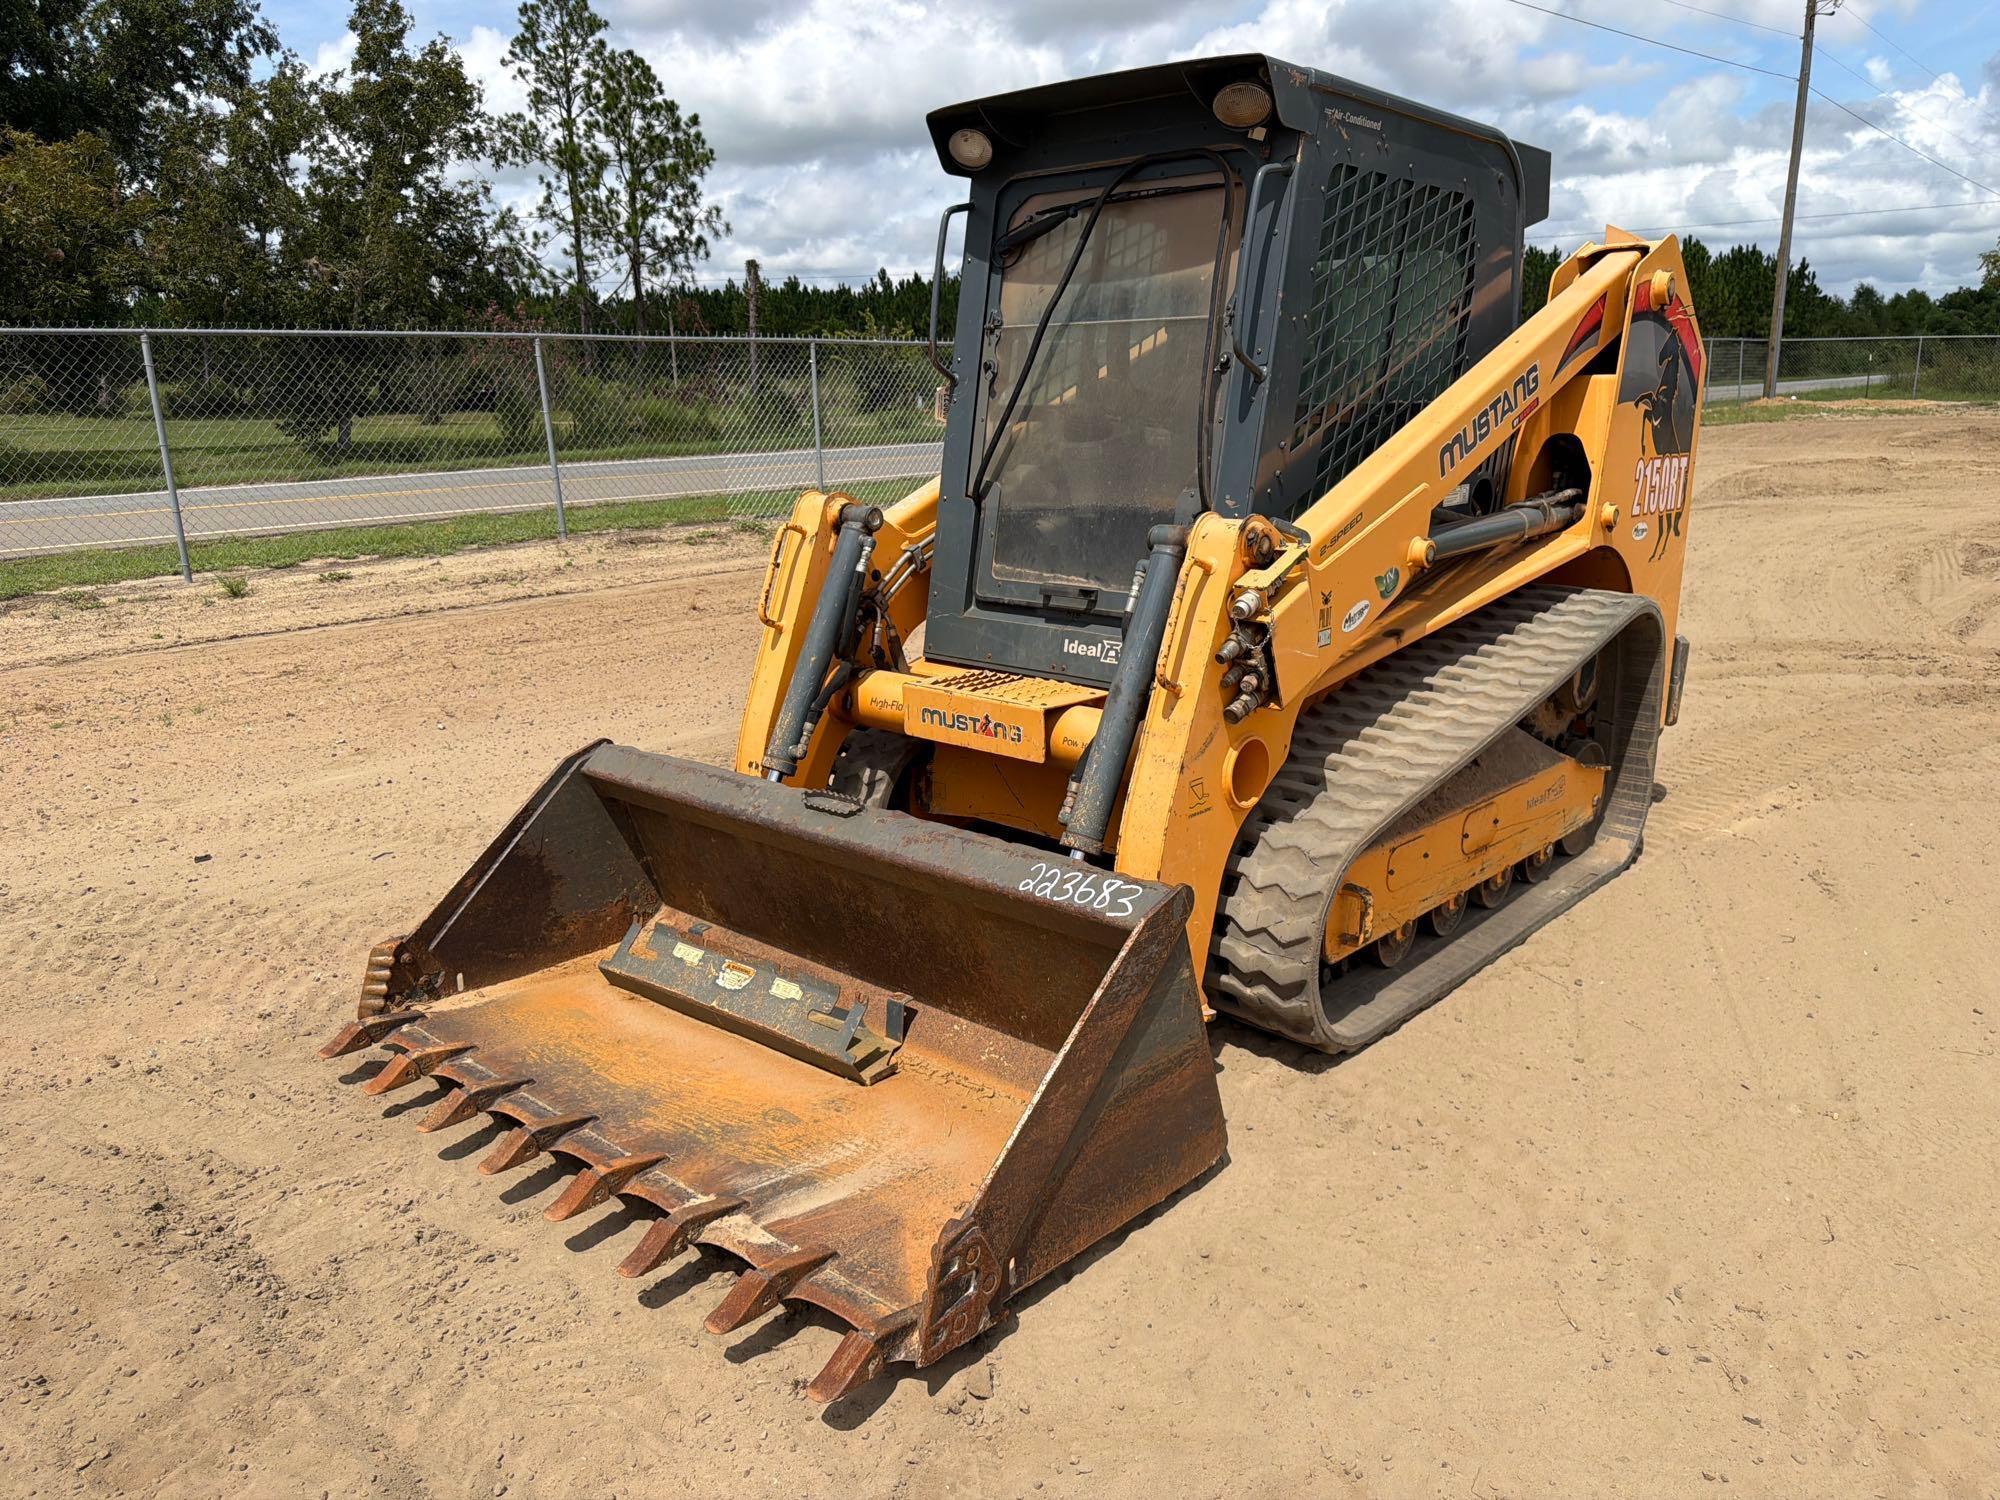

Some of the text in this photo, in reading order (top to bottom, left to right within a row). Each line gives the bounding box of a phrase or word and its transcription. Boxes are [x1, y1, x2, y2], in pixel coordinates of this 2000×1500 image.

[1333, 108, 1382, 130] Air-Conditioned
[1439, 362, 1539, 479] MUSTANG
[1631, 454, 1689, 518] 2150RT
[1319, 512, 1363, 557] 2-SPEED
[921, 706, 1023, 744] MUSTANG
[1019, 863, 1143, 917] 223683
